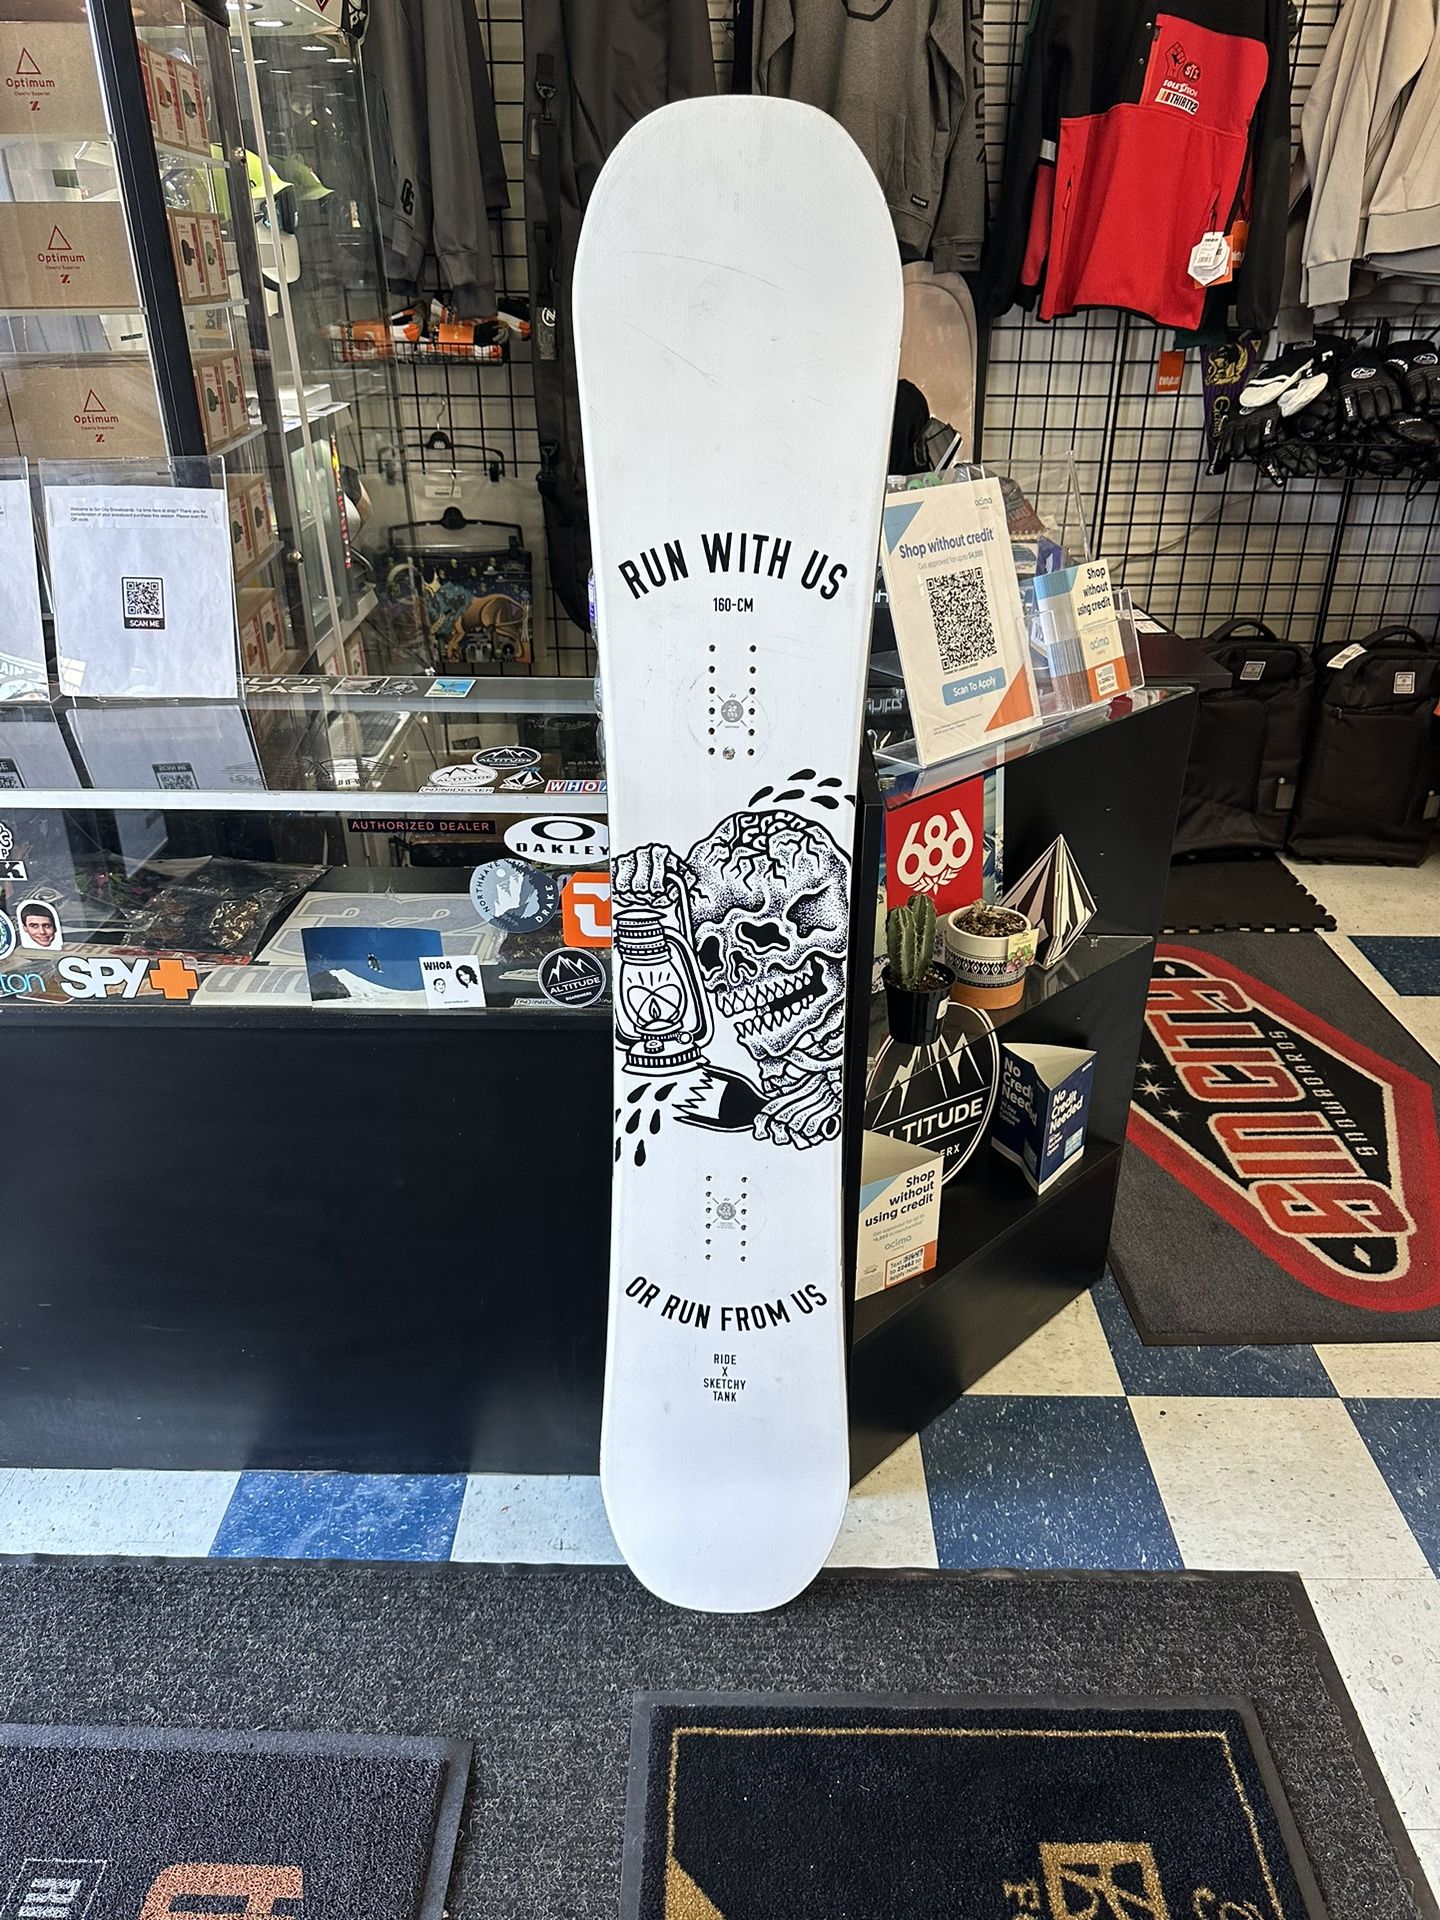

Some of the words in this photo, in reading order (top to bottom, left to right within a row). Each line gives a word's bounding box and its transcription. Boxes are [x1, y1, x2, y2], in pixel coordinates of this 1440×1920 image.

[6, 77, 56, 89] Optimum
[37, 253, 86, 263] Optimum
[73, 414, 120, 425] Optimum
[974, 496, 993, 507] acima
[899, 543, 927, 560] Shop
[927, 535, 966, 553] without
[966, 527, 995, 545] credit
[617, 539, 690, 601] RUN
[700, 531, 793, 580] WITH
[800, 549, 849, 601] US
[1086, 566, 1106, 580] Shop
[1082, 581, 1110, 597] without
[712, 597, 754, 613] 160-CM
[1077, 604, 1092, 617] using
[1091, 596, 1112, 612] credit
[129, 619, 149, 628] SCAN
[149, 619, 161, 628] ME
[952, 685, 969, 697] Scan
[968, 681, 978, 692] To
[978, 675, 997, 690] Apply
[351, 820, 435, 831] AUTHORIZED
[439, 821, 490, 832] DEALER
[516, 842, 609, 856] OAKLEY
[896, 808, 975, 886] 686
[475, 861, 501, 913] NORTHWAVE
[535, 883, 555, 924] DRAKE
[422, 960, 453, 972] WHOA
[58, 957, 150, 999] SPY
[549, 975, 602, 995] ALTITUDE
[1004, 1056, 1022, 1078] No
[1053, 1089, 1067, 1108] No
[1268, 1030, 1379, 1157] SNOWBOARDS
[1051, 1089, 1078, 1120] Credit
[889, 1097, 984, 1143] TITUDE
[1049, 1094, 1084, 1135] Needed
[905, 1169, 935, 1188] Shop
[888, 1180, 935, 1206] without
[865, 1207, 899, 1228] using
[900, 1192, 934, 1215] credit
[884, 1234, 912, 1250] acima
[625, 1276, 661, 1309] OR
[660, 1294, 711, 1330] RUN
[720, 1299, 791, 1332] FROM
[790, 1283, 828, 1315] US
[713, 1353, 737, 1366] RIDE
[721, 1366, 729, 1377] X
[702, 1377, 747, 1391] SKETCHY
[712, 1390, 737, 1402] TANK
